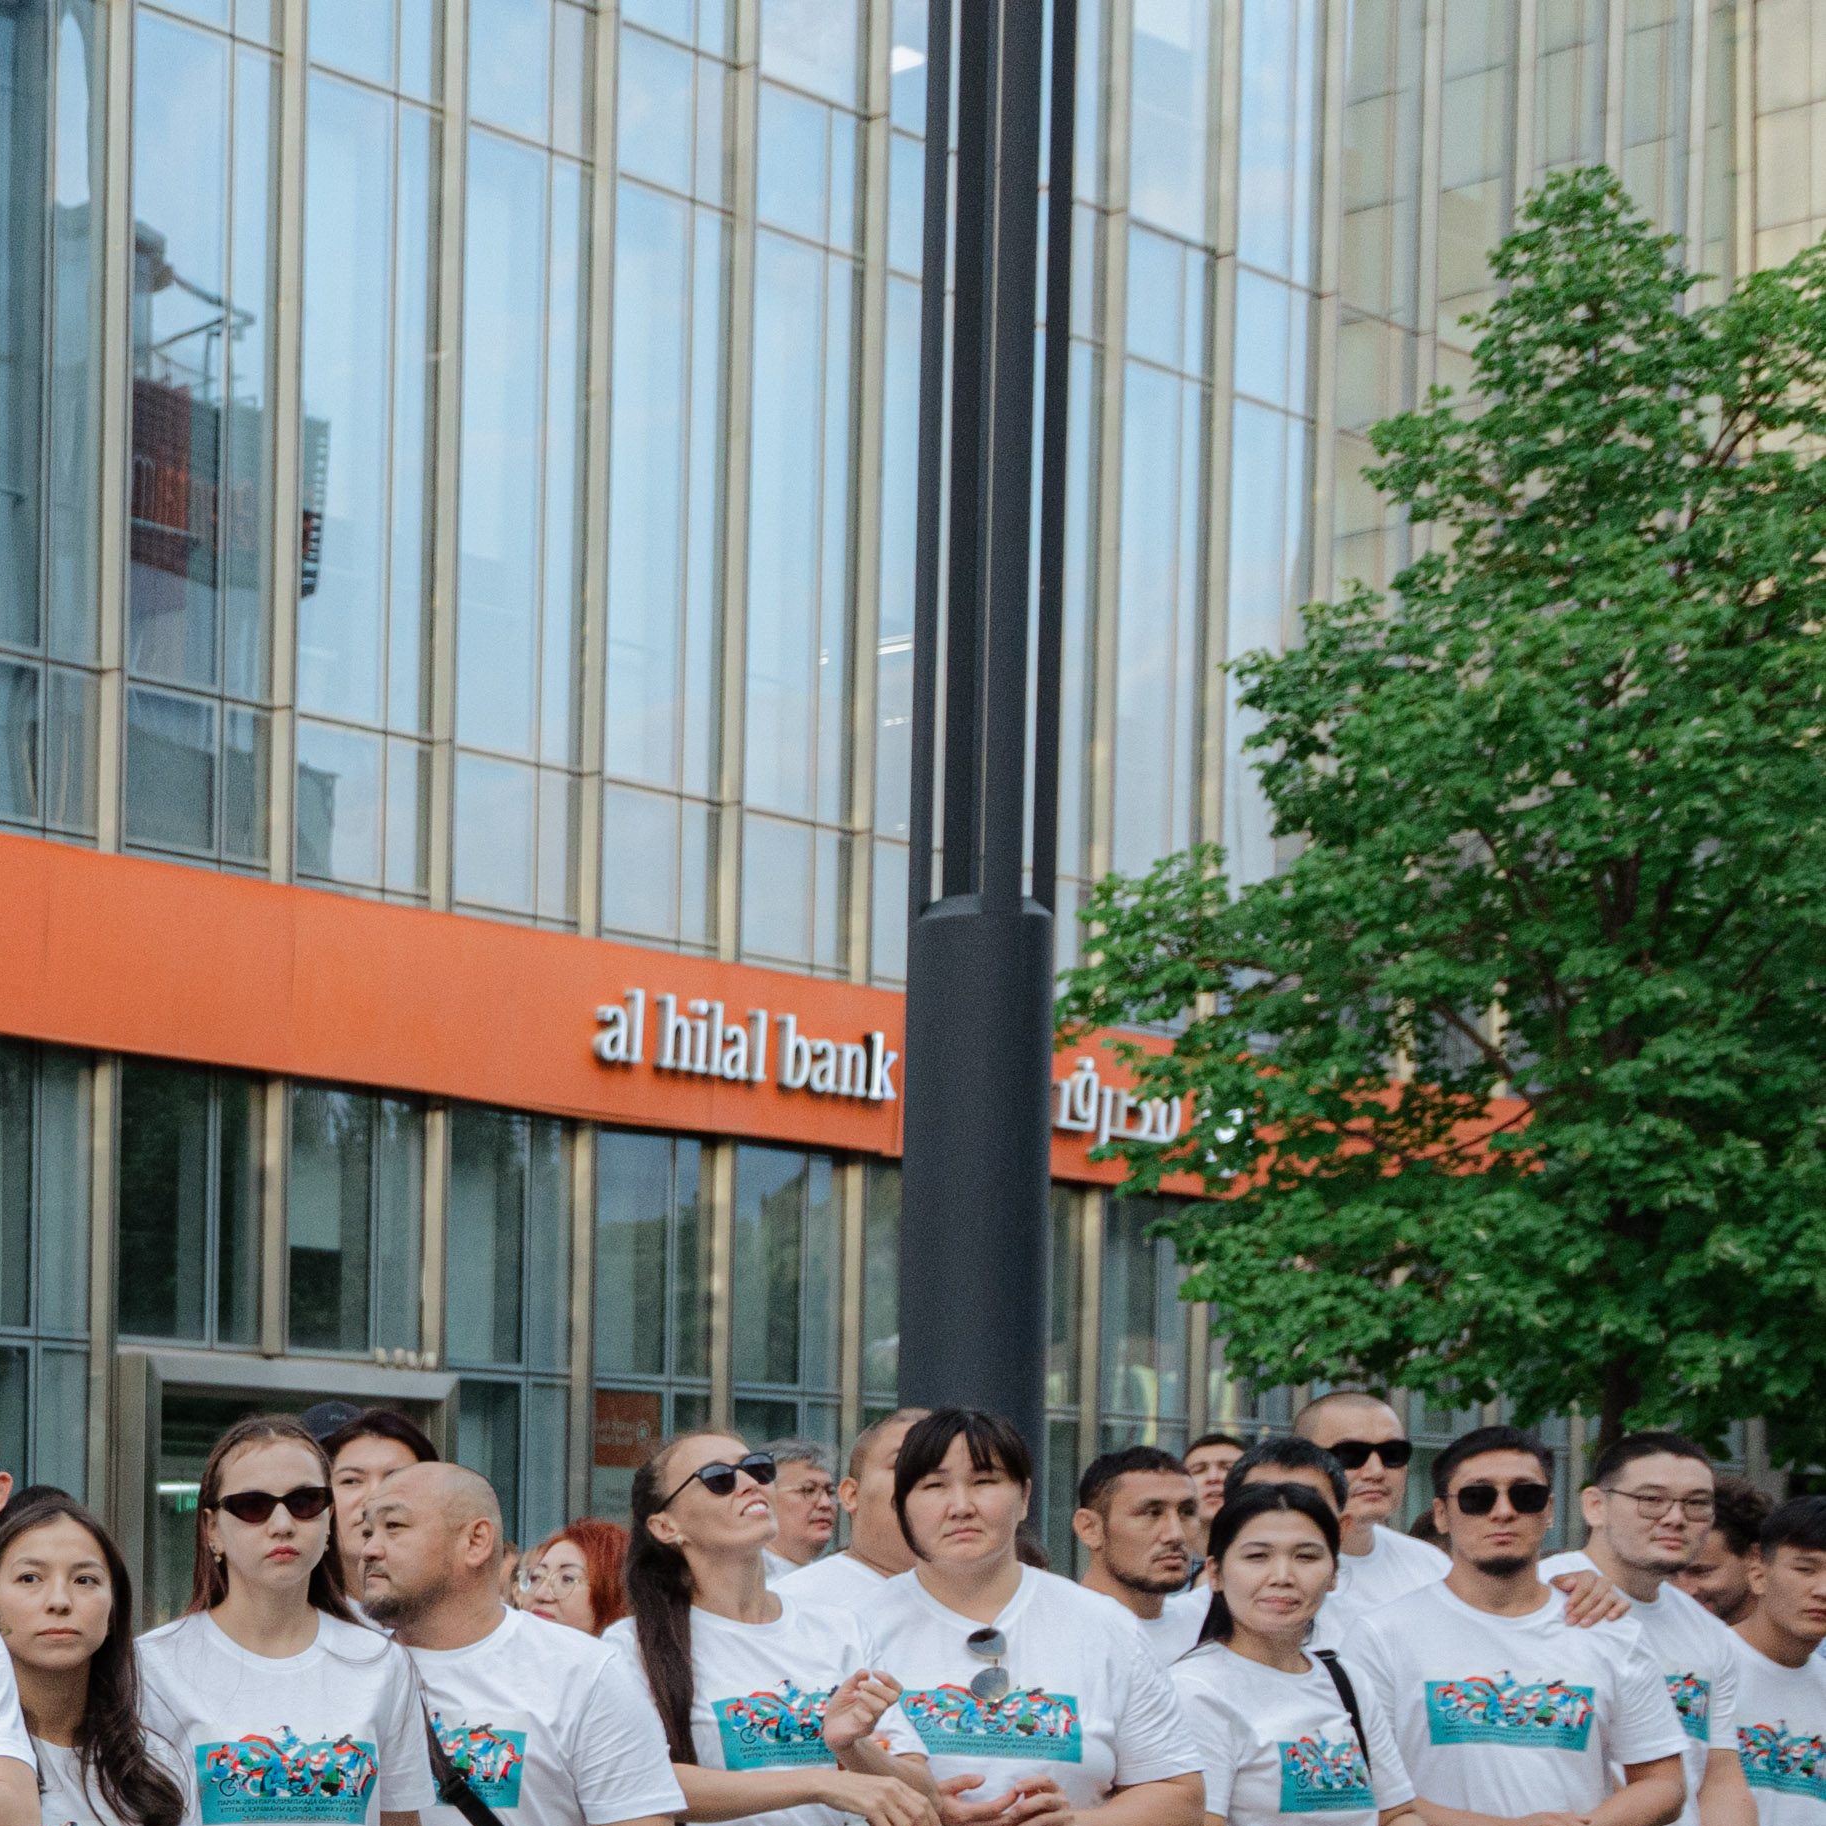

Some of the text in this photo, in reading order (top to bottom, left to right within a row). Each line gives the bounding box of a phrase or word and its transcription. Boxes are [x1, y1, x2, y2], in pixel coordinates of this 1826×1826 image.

[592, 987, 899, 1101] al hilal bank
